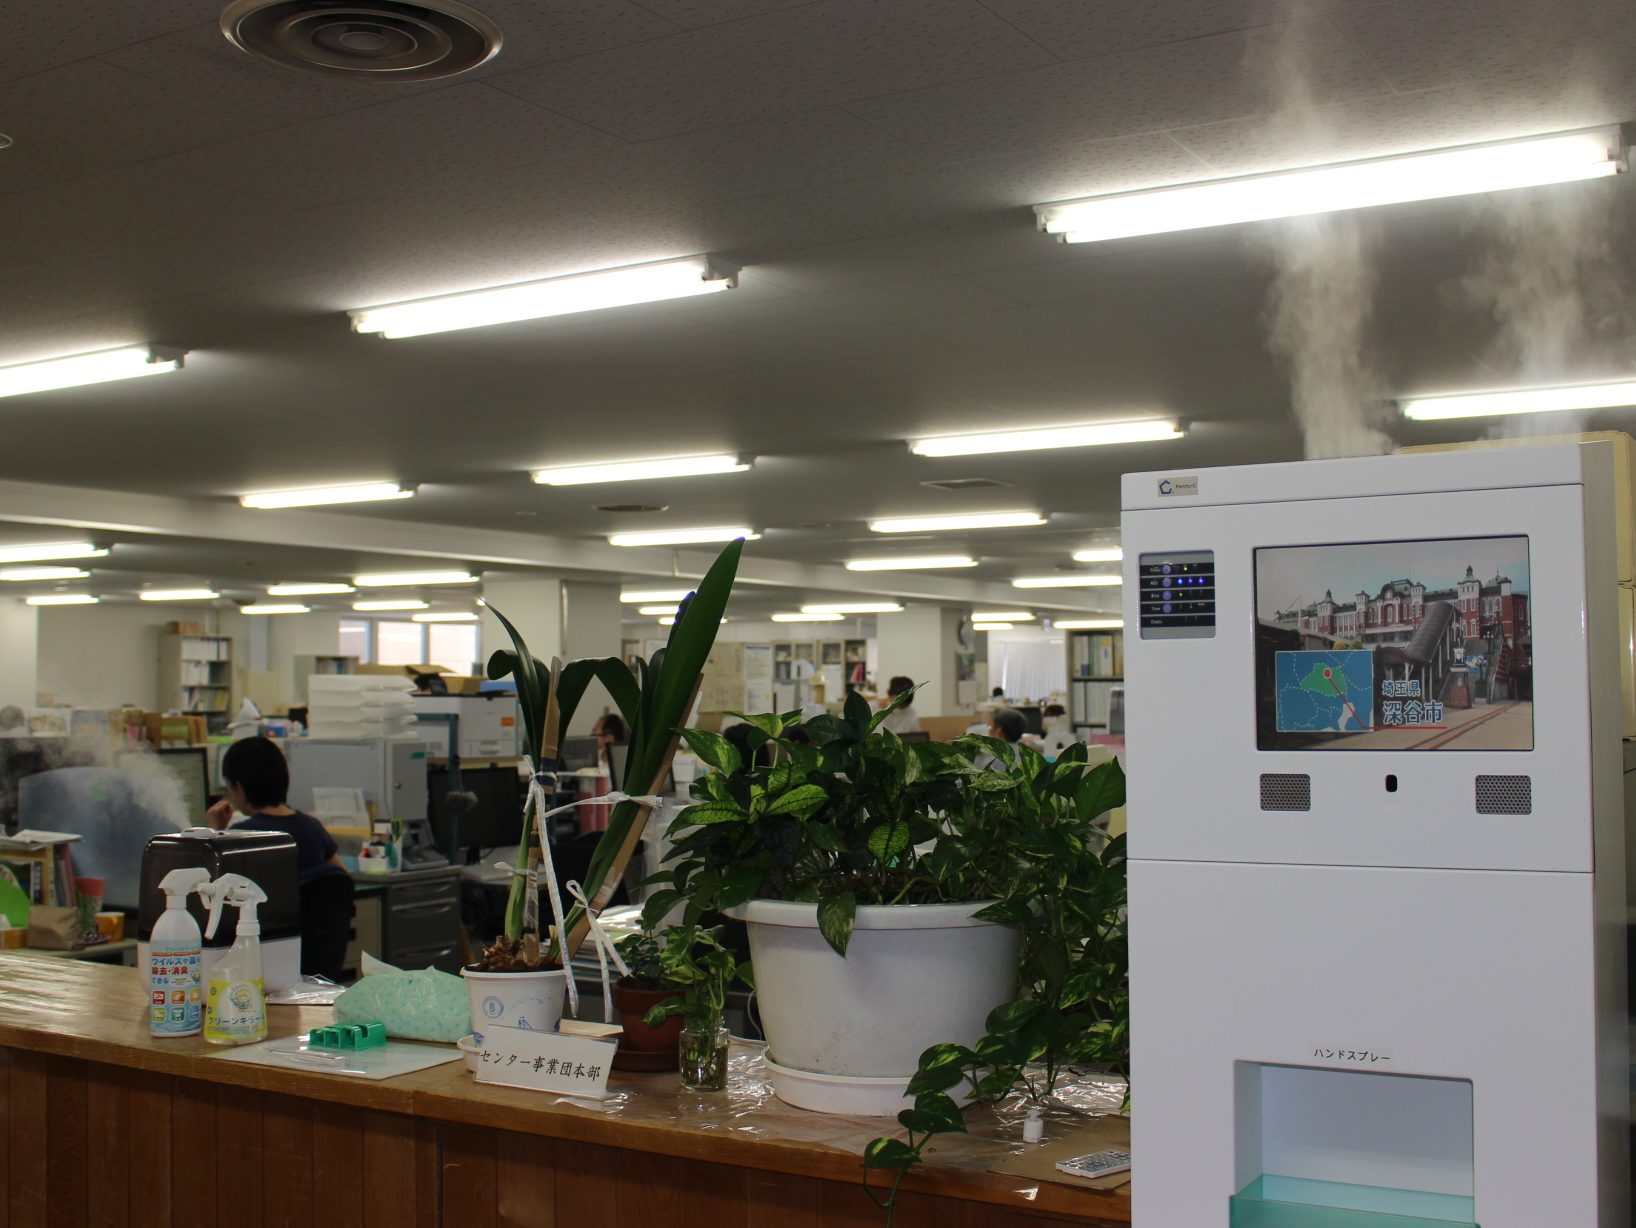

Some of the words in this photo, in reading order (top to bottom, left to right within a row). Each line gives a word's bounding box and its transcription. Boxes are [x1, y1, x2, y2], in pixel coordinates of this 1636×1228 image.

[1382, 679, 1421, 697] 埼玉県
[1383, 700, 1443, 725] 深谷市
[480, 1050, 601, 1082] センター事業団本部
[1314, 1049, 1390, 1062] ハンドスプレー
